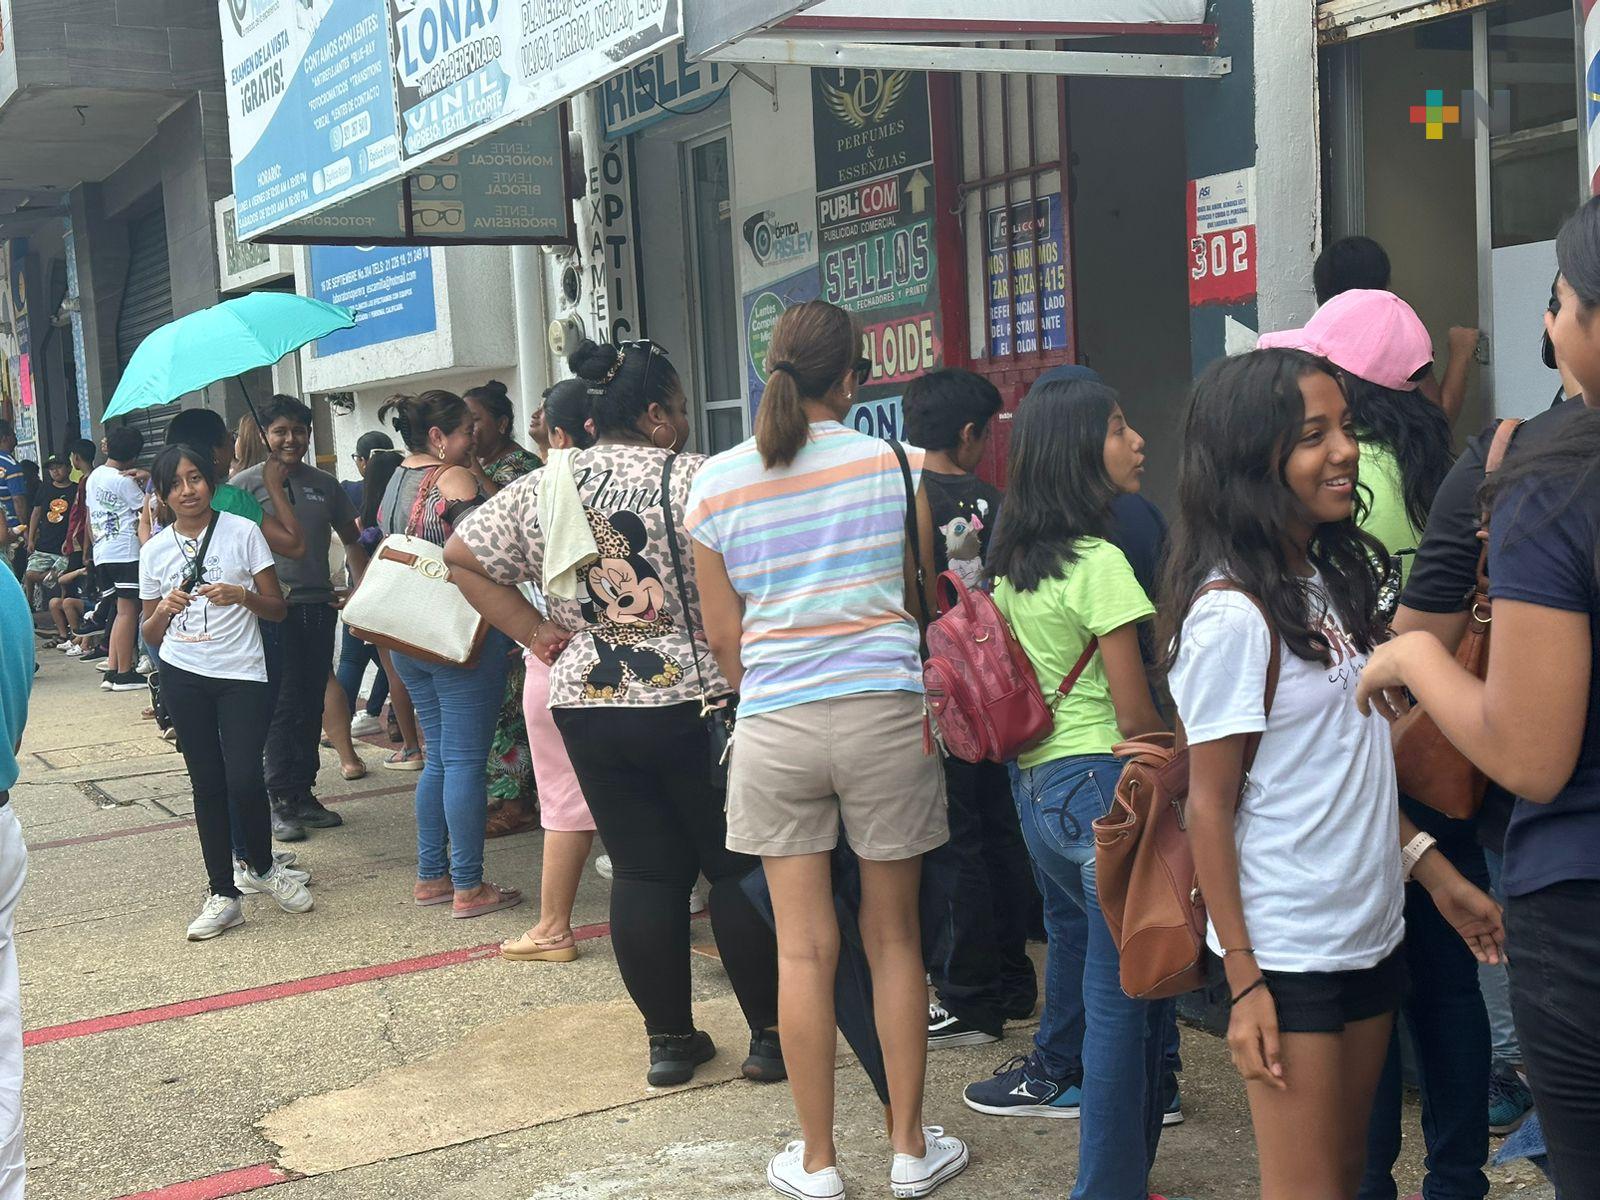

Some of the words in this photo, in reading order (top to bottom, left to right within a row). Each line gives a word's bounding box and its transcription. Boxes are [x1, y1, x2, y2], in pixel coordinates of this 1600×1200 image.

[231, 55, 255, 86] EXAMEN
[254, 48, 263, 70] DE
[262, 42, 272, 65] LA
[270, 28, 290, 57] VISTA
[304, 38, 339, 74] CONTAMOS
[338, 27, 354, 52] CON
[352, 13, 379, 43] LENTES:
[240, 58, 285, 117] ¡GRATIS!
[409, 71, 498, 130] VINIL
[836, 119, 905, 152] PERFUMES
[838, 151, 907, 182] ESSENZIAS
[866, 146, 875, 159] &
[823, 224, 859, 242] PUBLICIDAD
[860, 215, 896, 234] COMERCIAL
[825, 222, 930, 305] SELLOS
[1191, 230, 1248, 280] 302
[856, 291, 896, 310] FECHADORES
[992, 273, 1035, 300] ZARGOZA
[1043, 294, 1065, 311] LADO
[991, 324, 1005, 338] DEL
